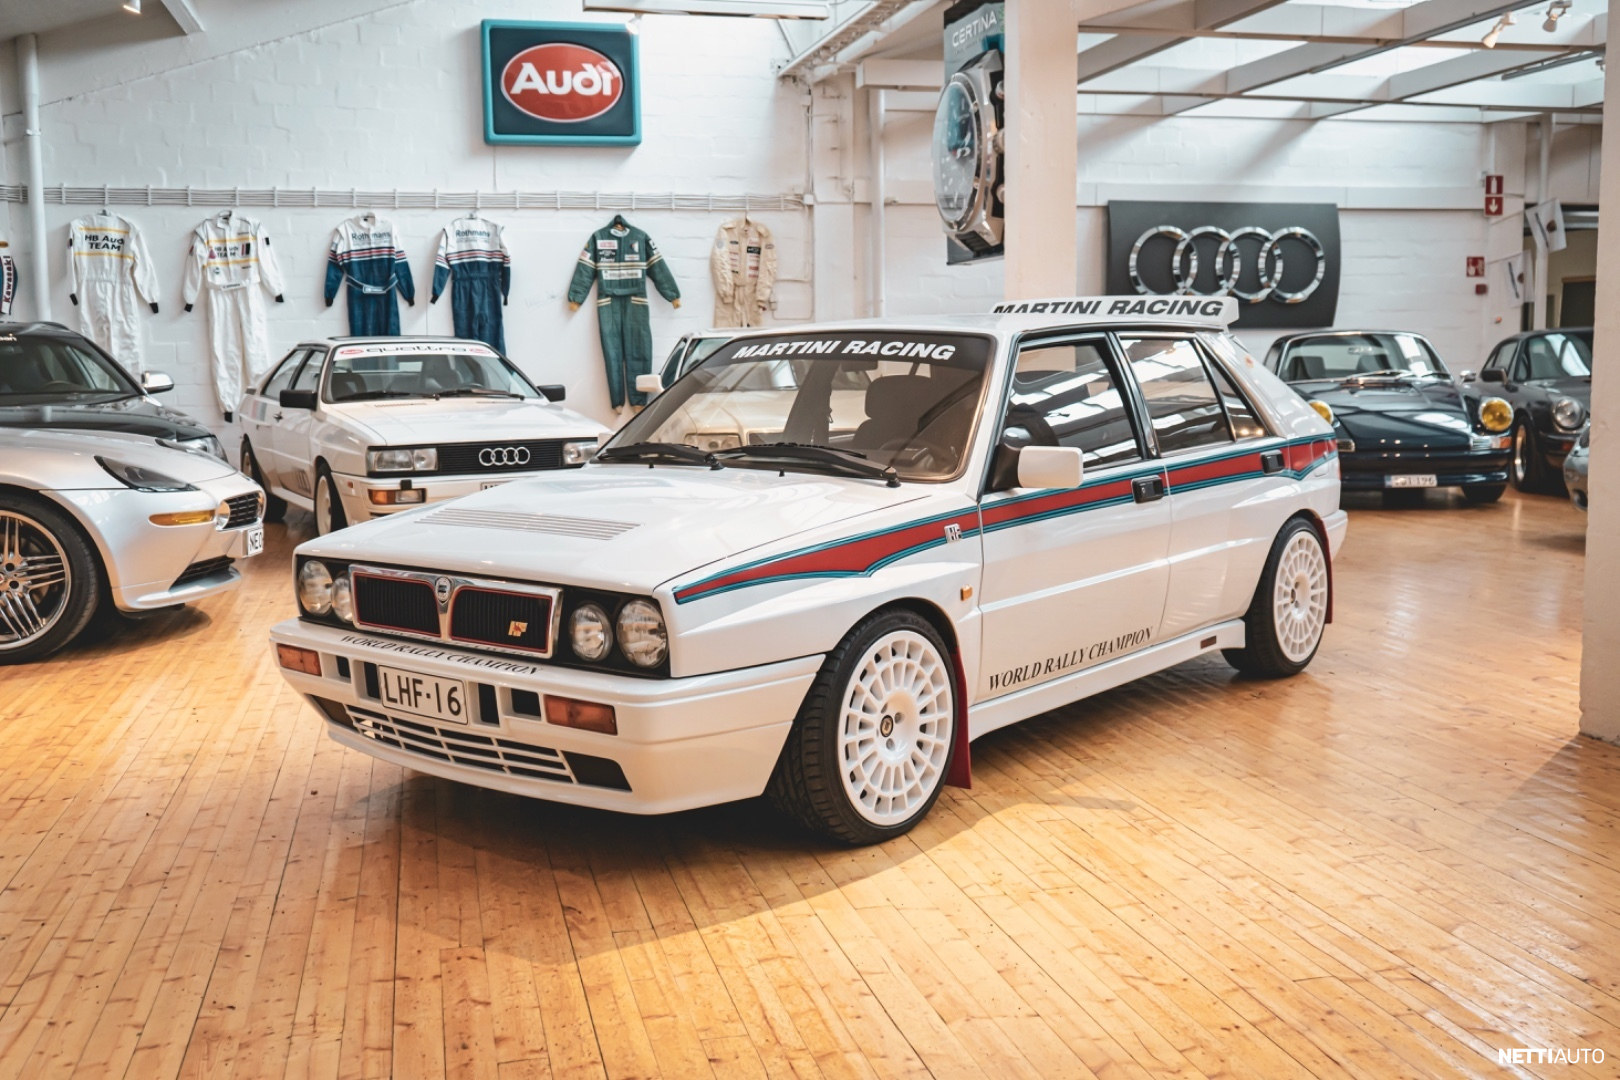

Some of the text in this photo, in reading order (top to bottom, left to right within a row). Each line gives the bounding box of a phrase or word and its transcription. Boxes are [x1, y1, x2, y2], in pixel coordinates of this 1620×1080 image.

[952, 11, 997, 47] CERTINA
[509, 62, 613, 96] Audi
[89, 242, 122, 252] TEAM
[993, 299, 1224, 316] MARTINI RACING
[366, 345, 467, 353] quattro
[731, 340, 956, 361] MARTINI RACING
[340, 634, 545, 675] WORLD RALLY CHAMPION
[989, 626, 1153, 691] WORLD RALLY CHAMPION
[383, 672, 461, 716] LHF-16
